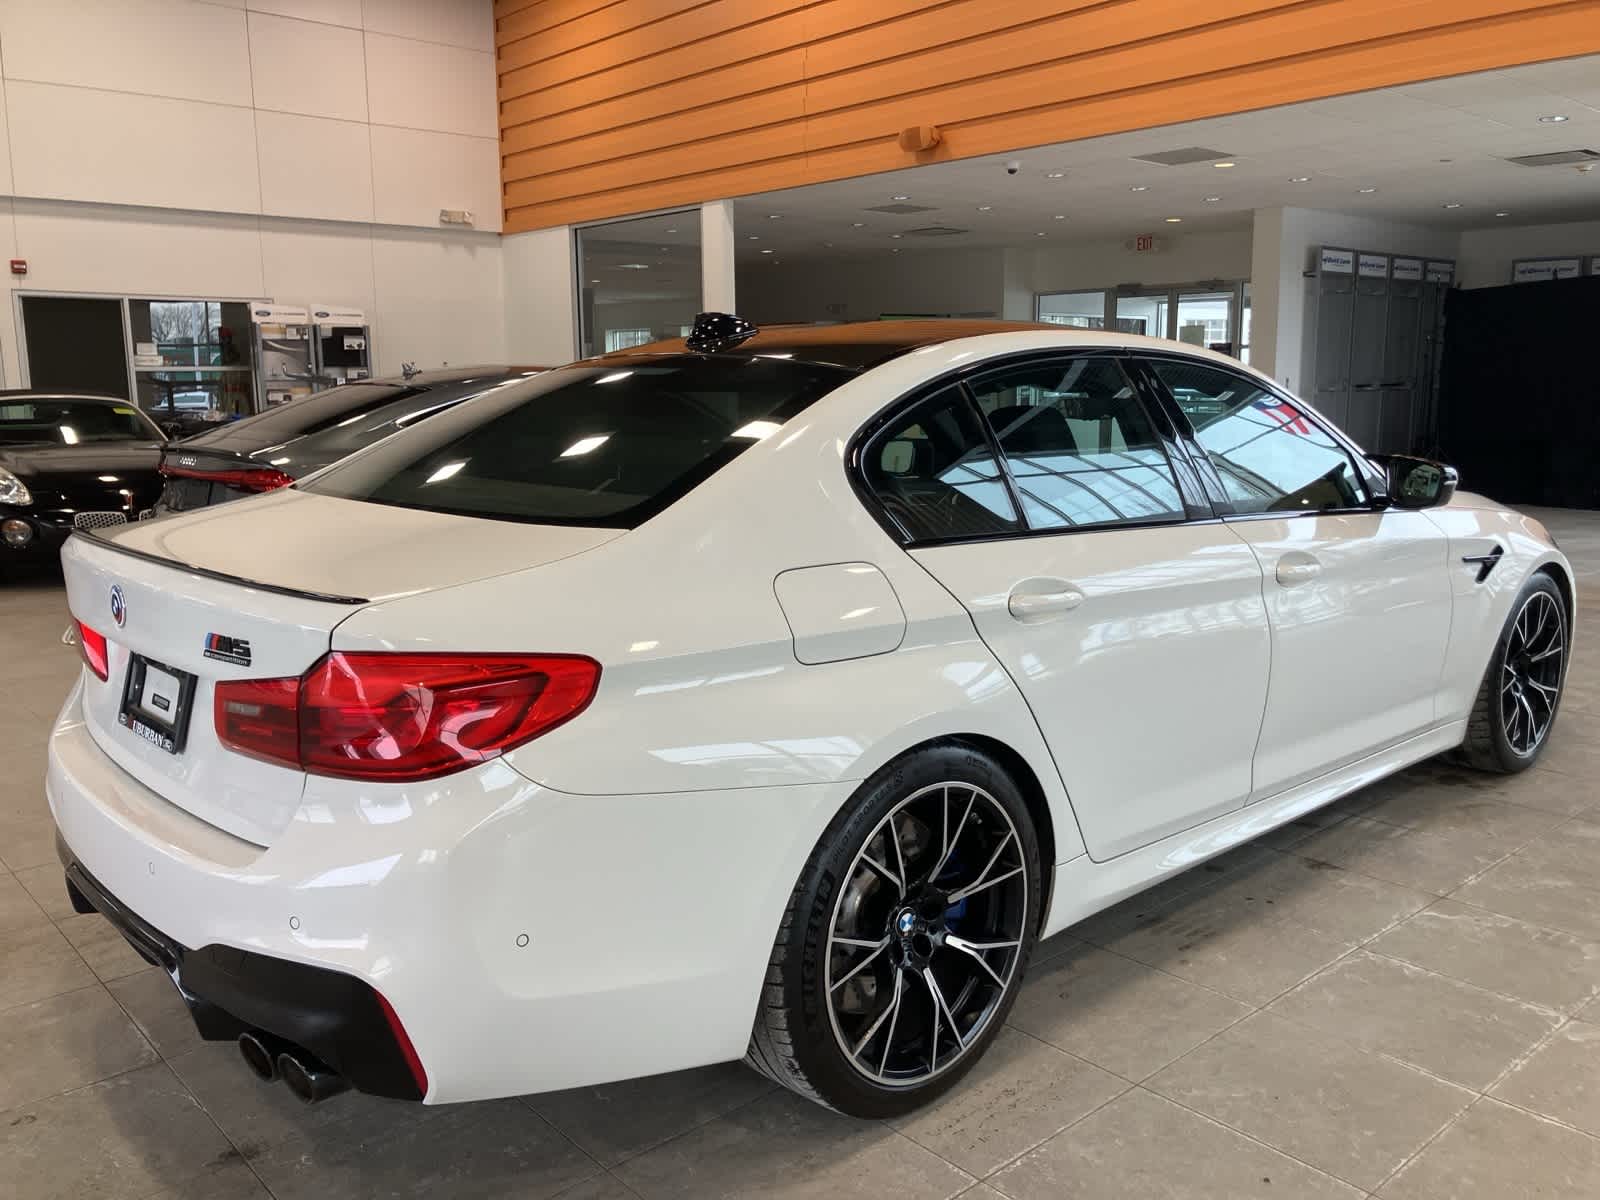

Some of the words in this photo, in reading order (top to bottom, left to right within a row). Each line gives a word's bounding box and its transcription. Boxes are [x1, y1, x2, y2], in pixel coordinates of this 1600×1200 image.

[1137, 235, 1152, 251] EXIT
[213, 634, 251, 657] M5
[128, 717, 164, 746] UBURBAN
